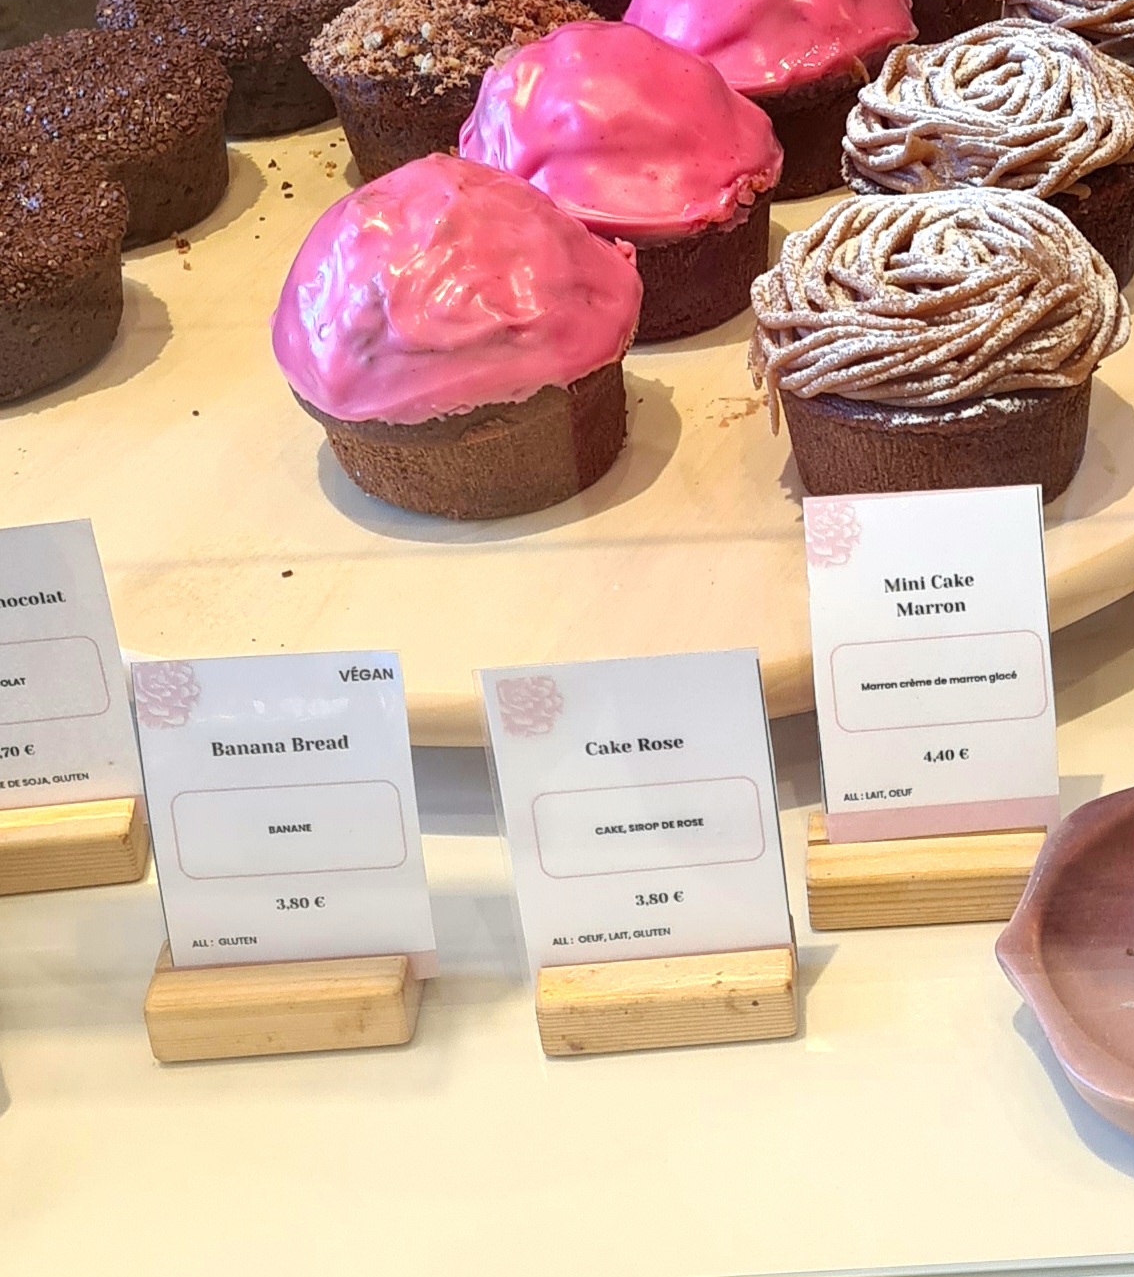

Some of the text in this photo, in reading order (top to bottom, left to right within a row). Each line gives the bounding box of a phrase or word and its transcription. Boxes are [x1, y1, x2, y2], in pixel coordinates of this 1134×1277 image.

[884, 573, 975, 594] Mini Cake
[896, 601, 966, 617] Marron
[338, 665, 394, 683] VÉGAN
[860, 670, 1018, 692] Marron crème de marron glacé
[24, 744, 35, 756] €
[211, 734, 350, 757] Banana Bread
[585, 737, 684, 756] Cake Rose
[923, 748, 969, 763] 4,40 €
[6, 779, 21, 789] DE
[51, 772, 90, 784] GLUTEN
[843, 792, 860, 802] ALL
[865, 790, 887, 800] LAIT,
[888, 787, 913, 798] OEUF
[268, 823, 313, 835] BANANE
[594, 817, 705, 836] CAKE, SIROP DE ROSE
[275, 896, 326, 911] 3,80 €
[635, 890, 684, 906] 3,80 €
[191, 939, 209, 948] ALL
[218, 936, 258, 946] GLUTEN
[552, 936, 570, 946] ALL
[577, 933, 608, 944] OEUF,
[608, 930, 632, 941] LAIT,
[632, 927, 671, 939] GLUTEN
